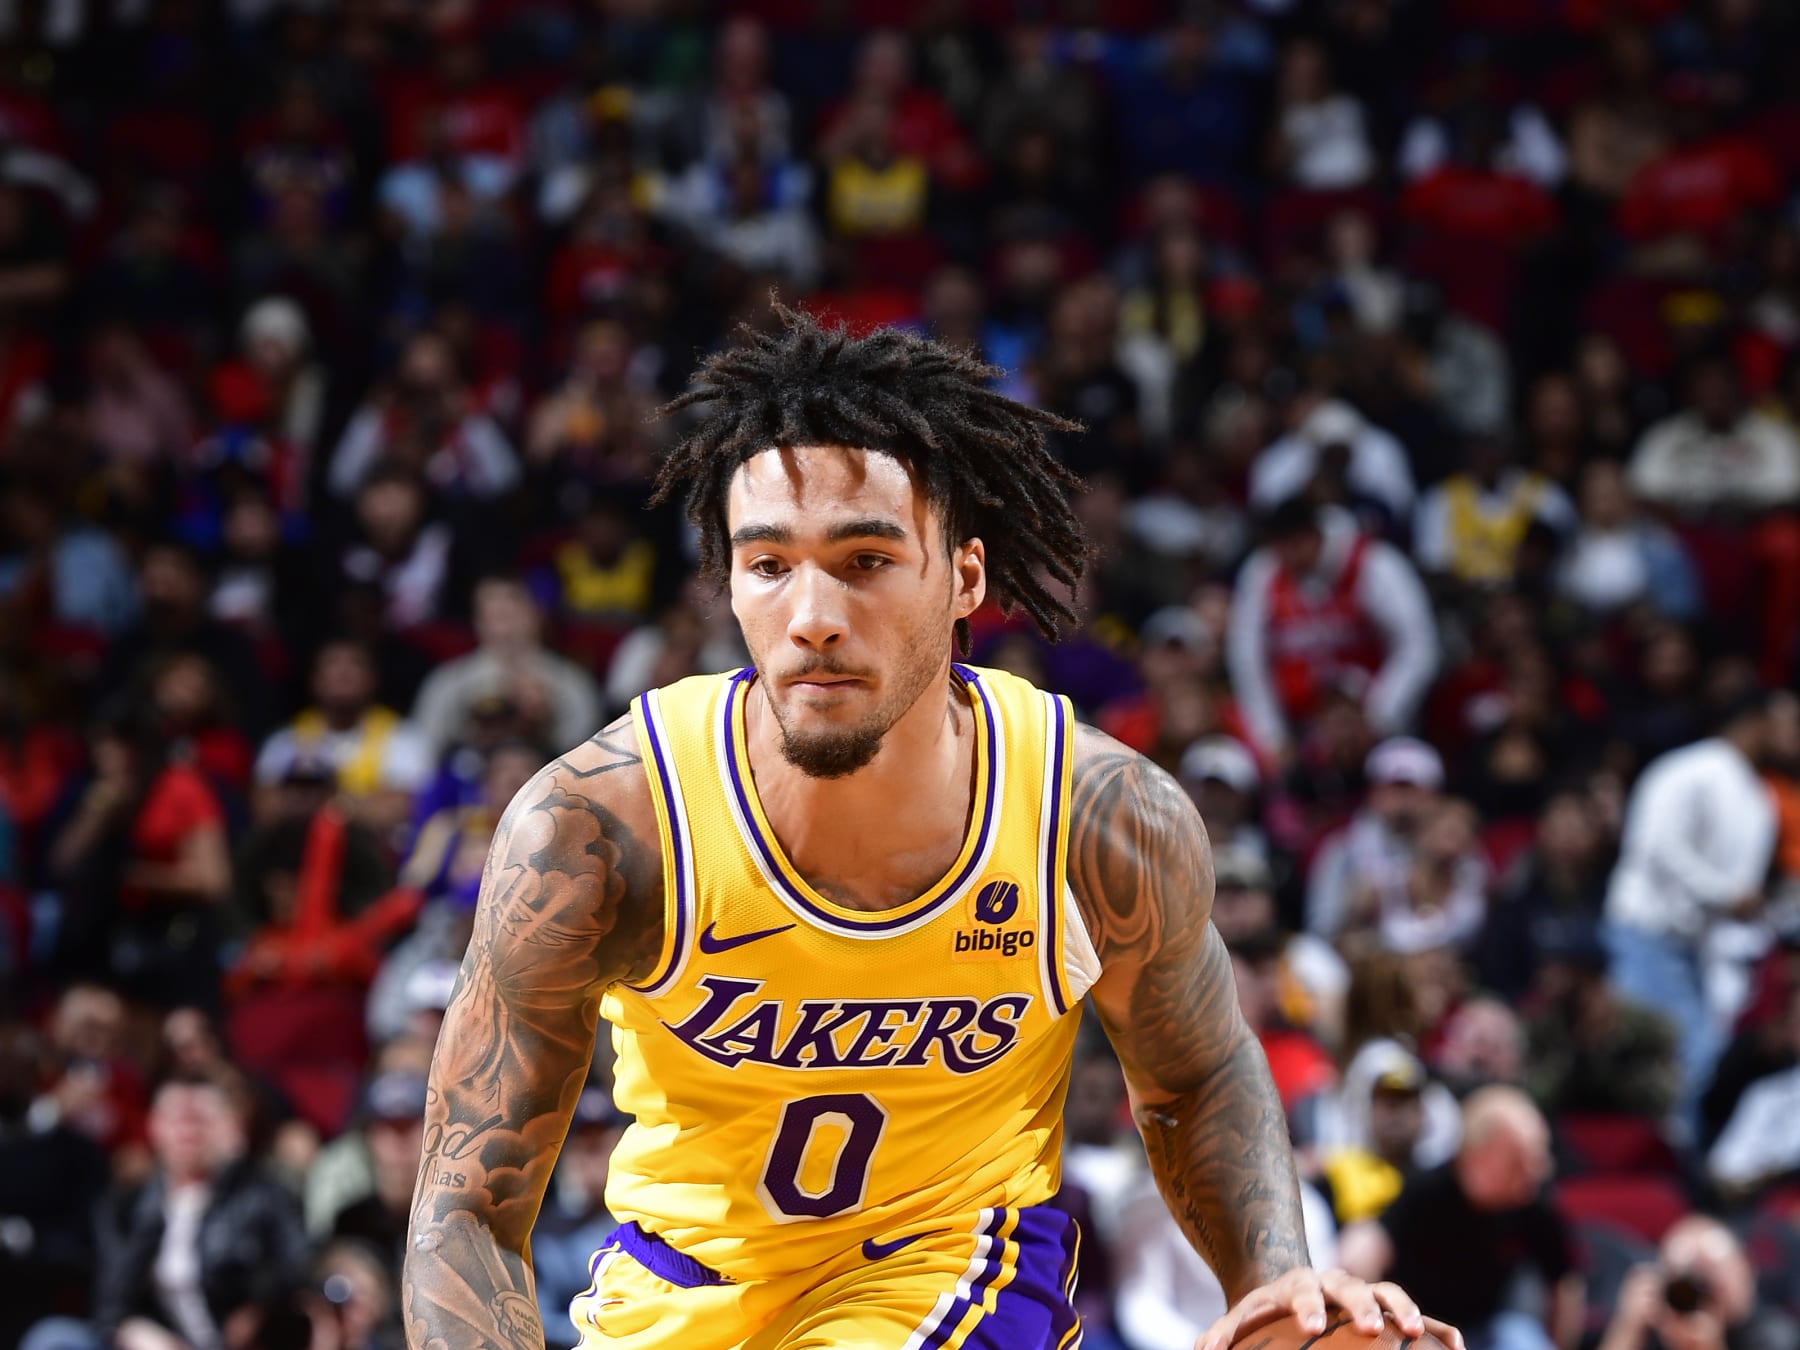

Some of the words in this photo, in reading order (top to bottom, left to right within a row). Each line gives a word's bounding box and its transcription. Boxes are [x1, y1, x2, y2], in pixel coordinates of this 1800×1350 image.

[955, 928, 1034, 957] bibigo
[659, 974, 1034, 1075] LAKERS
[756, 1093, 890, 1225] 0
